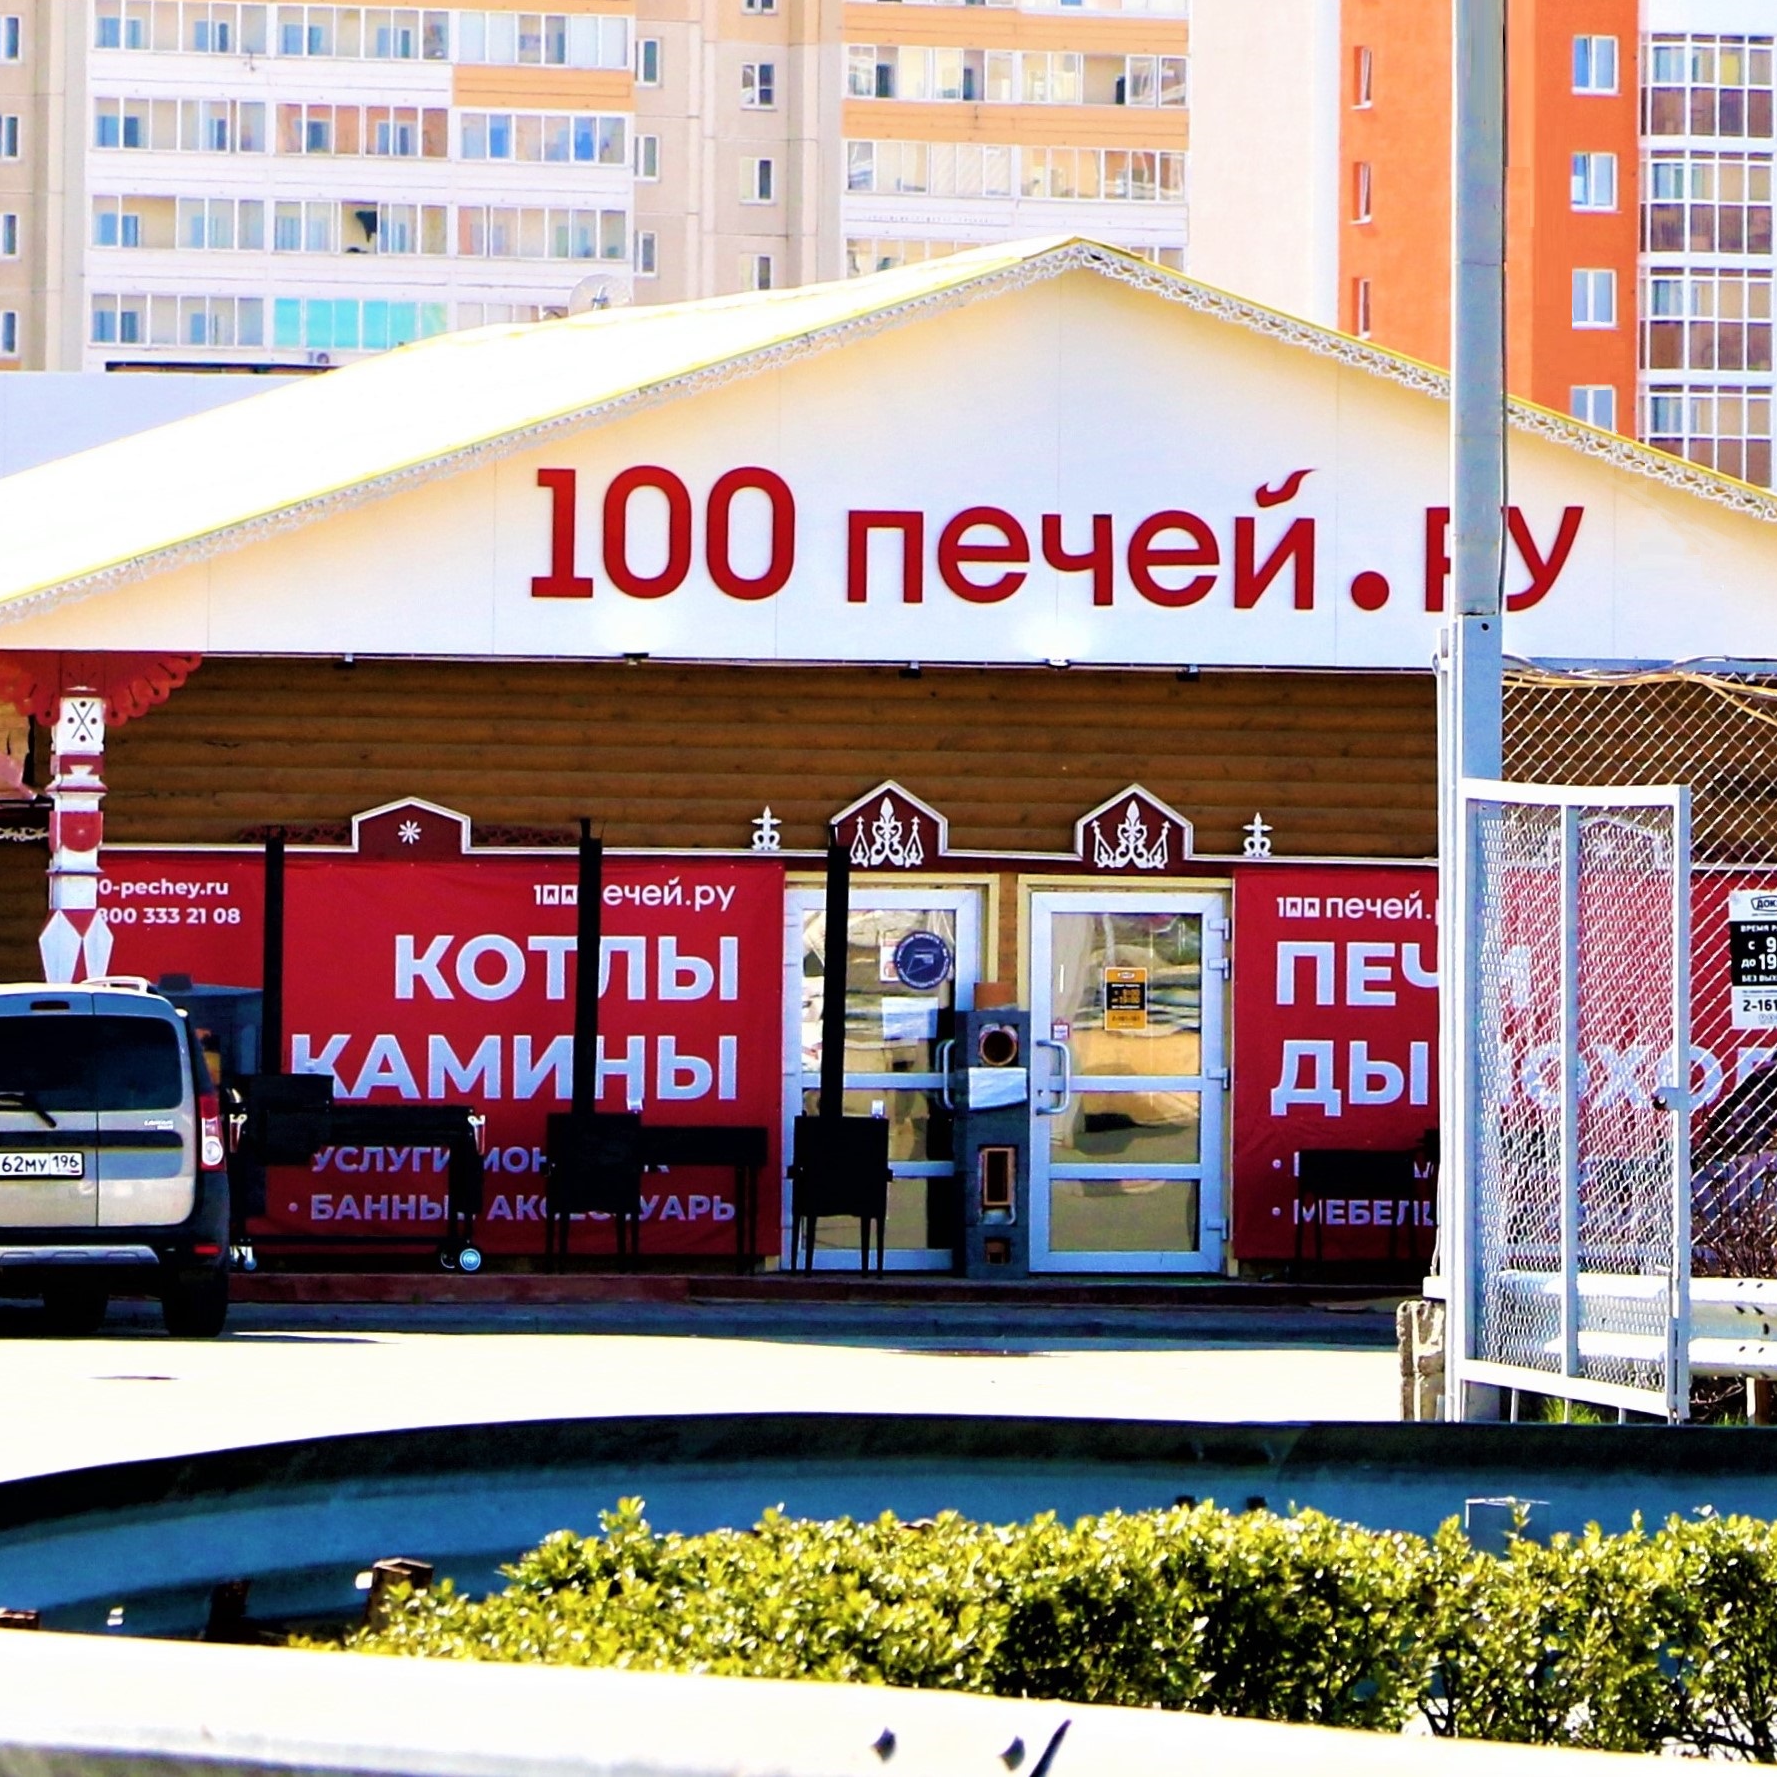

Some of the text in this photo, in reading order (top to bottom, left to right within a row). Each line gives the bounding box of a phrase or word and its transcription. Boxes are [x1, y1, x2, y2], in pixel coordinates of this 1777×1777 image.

[531, 465, 796, 601] 100
[601, 875, 736, 912] ечей.ру
[142, 907, 181, 924] 333
[186, 908, 207, 924] 21
[213, 908, 241, 924] 08
[1276, 896, 1321, 918] 100
[1740, 924, 1770, 932] ВРЕМЯ
[394, 934, 739, 1001] КОТЛЫ
[1741, 974, 1758, 982] БЕЗ
[291, 1033, 738, 1101] КАМИНЫ
[52, 1154, 79, 1169] 196
[310, 1194, 474, 1221] БАННЫ
